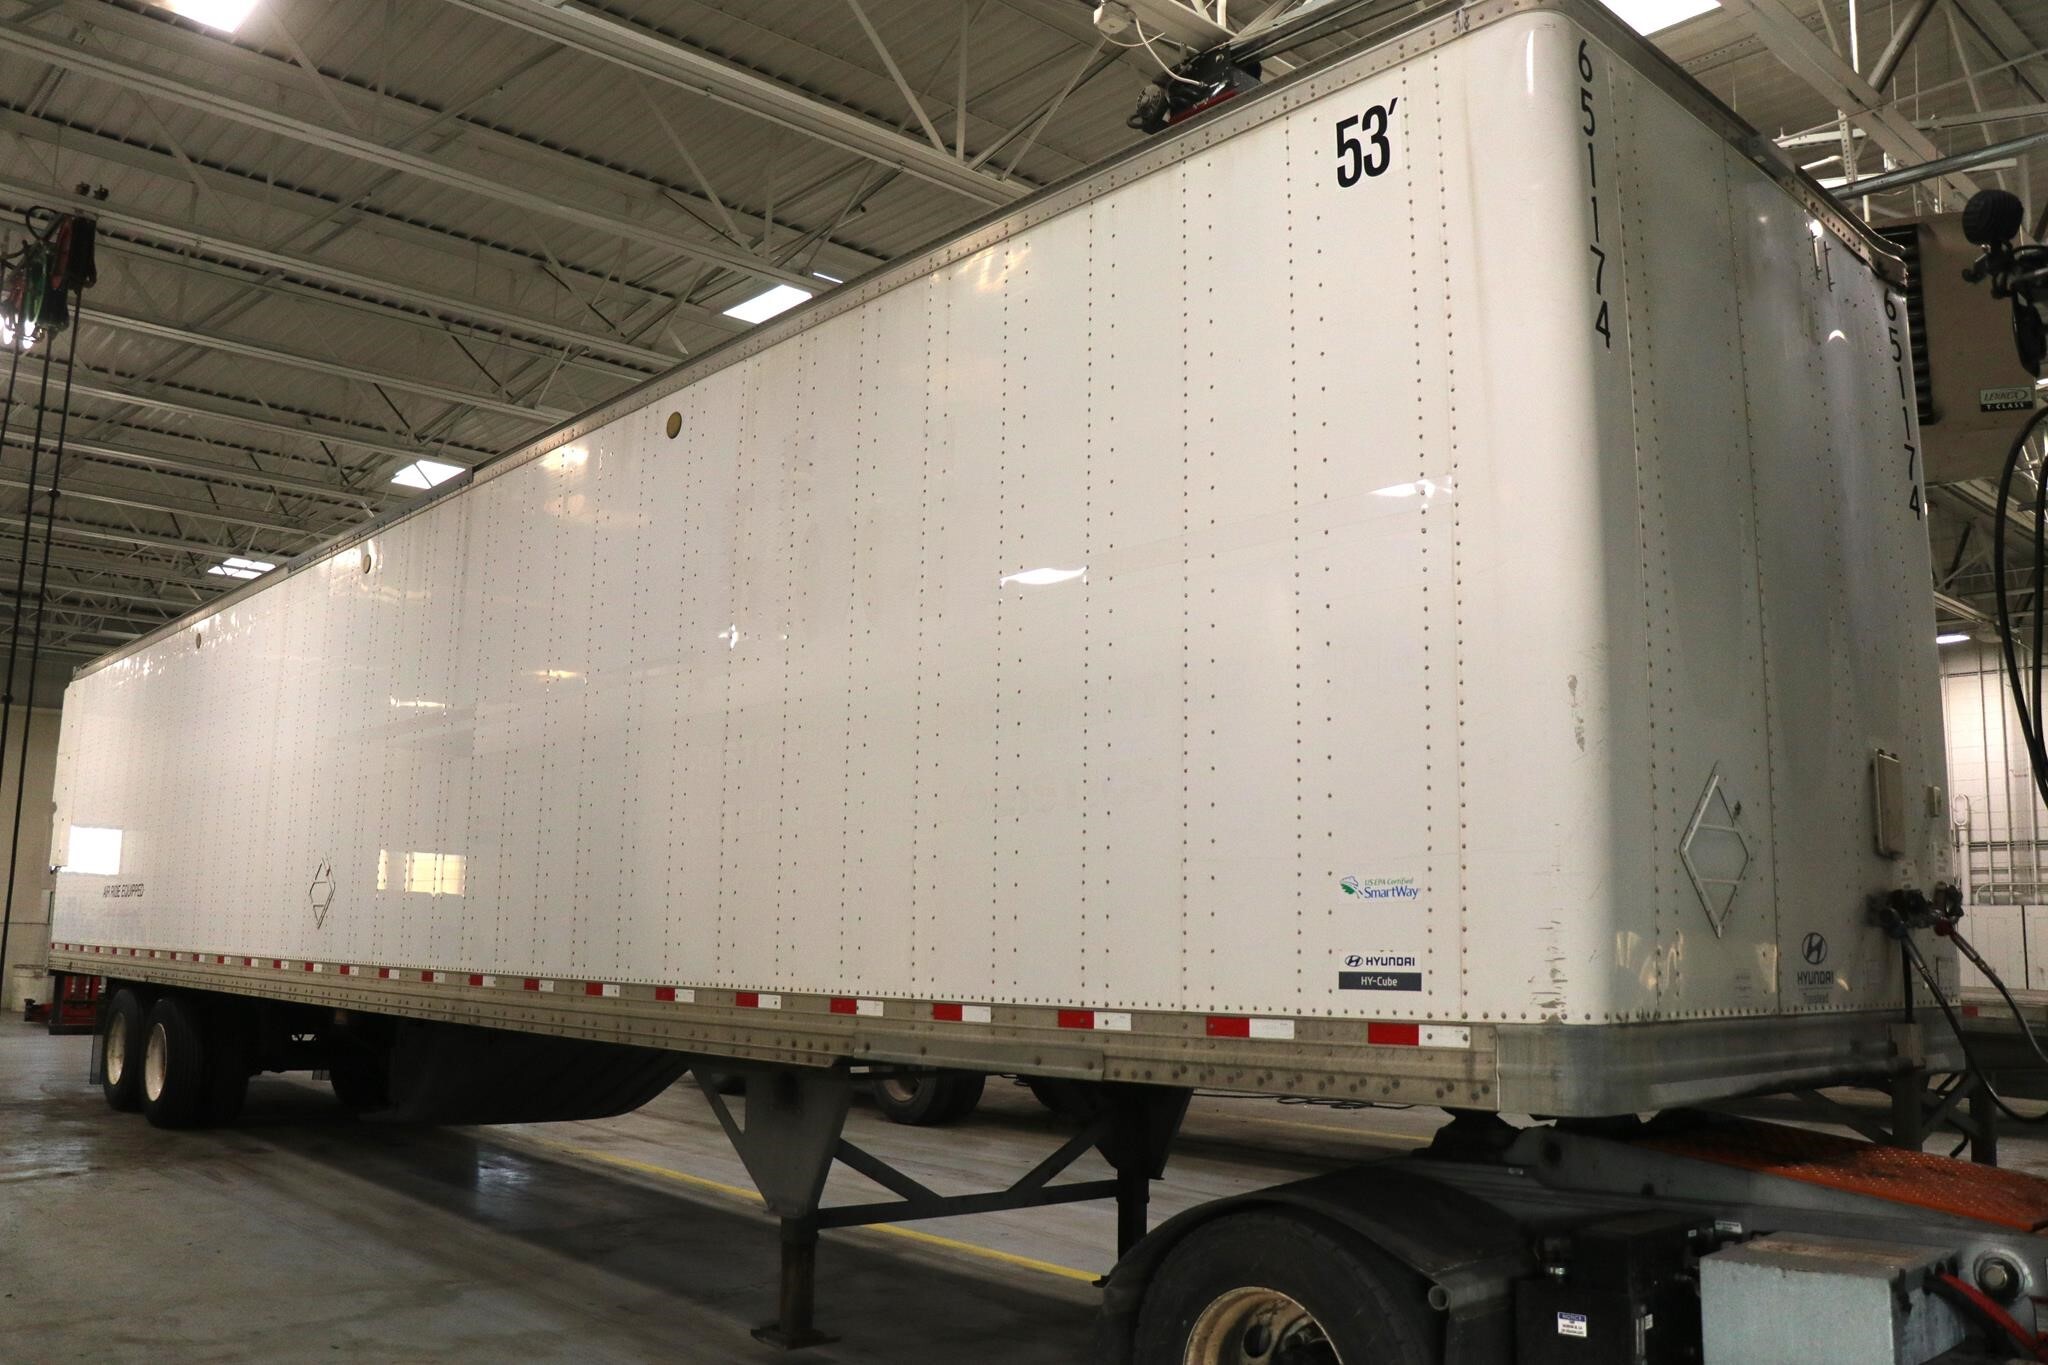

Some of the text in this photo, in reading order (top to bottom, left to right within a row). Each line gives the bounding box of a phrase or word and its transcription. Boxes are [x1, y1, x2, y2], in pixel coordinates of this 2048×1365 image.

[1578, 39, 1611, 349] 651174
[1884, 288, 1921, 520] 651174
[1364, 885, 1419, 899] SmartWay
[1365, 956, 1416, 967] HYUNDAI
[1360, 976, 1398, 987] HY-Cube
[1797, 971, 1835, 985] HYUNDAI
